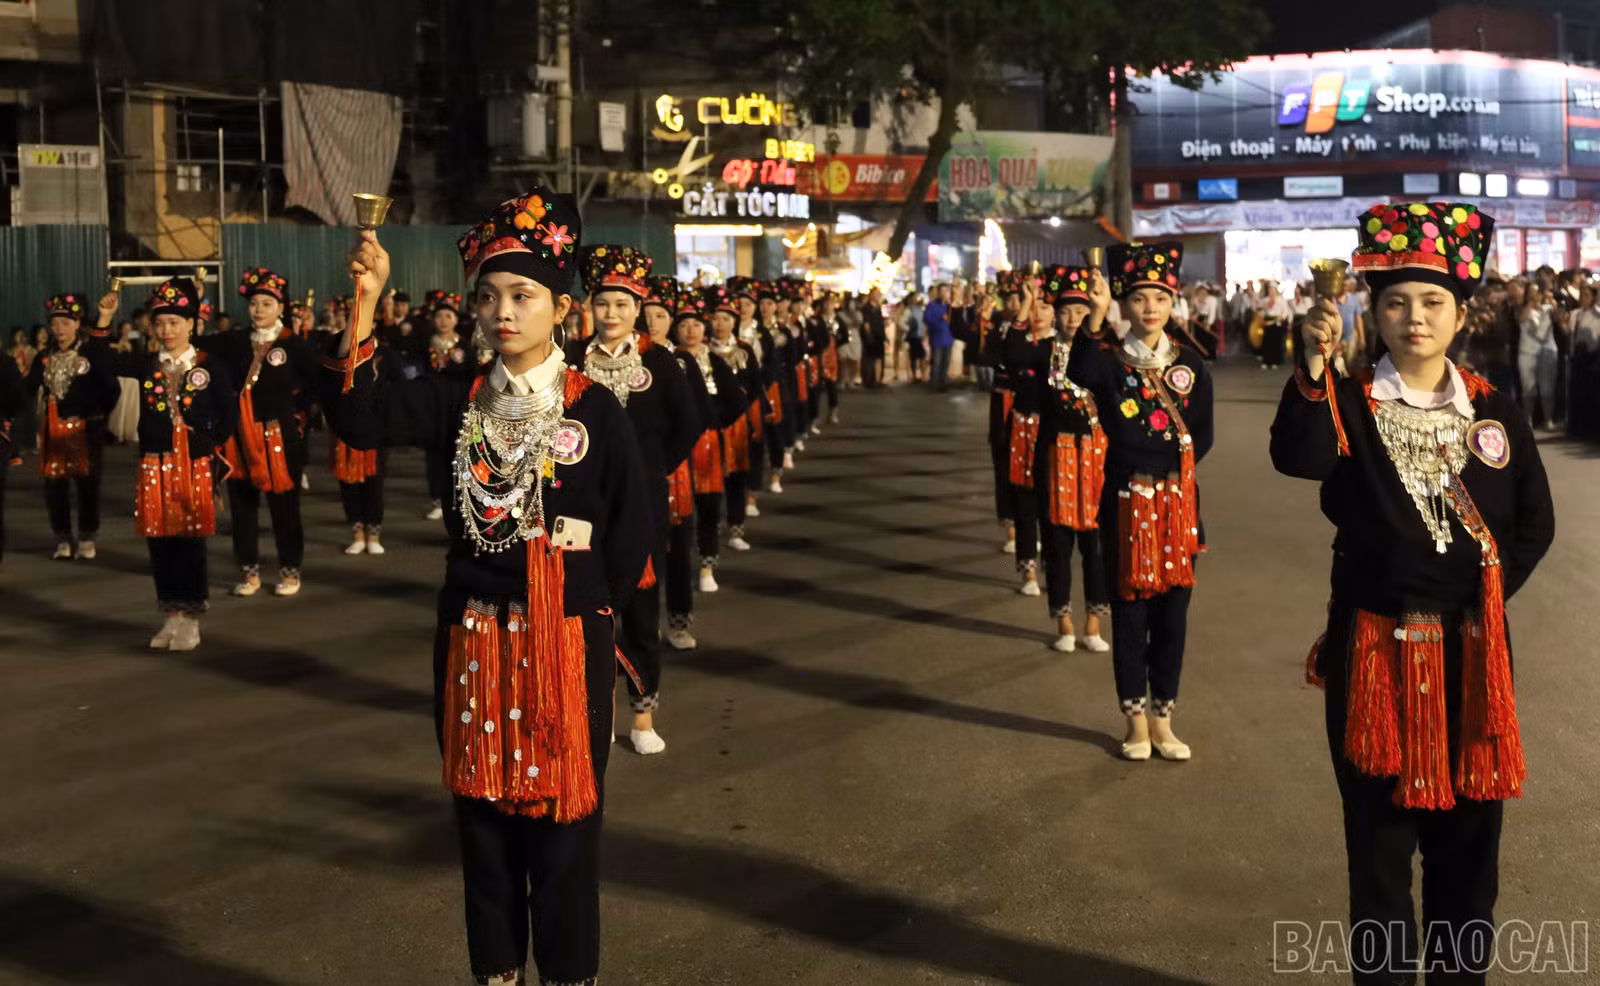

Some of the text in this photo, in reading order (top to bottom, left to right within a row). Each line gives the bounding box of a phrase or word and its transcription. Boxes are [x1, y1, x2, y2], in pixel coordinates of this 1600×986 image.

[1181, 139, 1222, 161] Điện
[1230, 137, 1275, 159] thoại
[1295, 135, 1333, 156] Máy
[949, 156, 991, 190] HOA
[998, 147, 1038, 189] QUẢ
